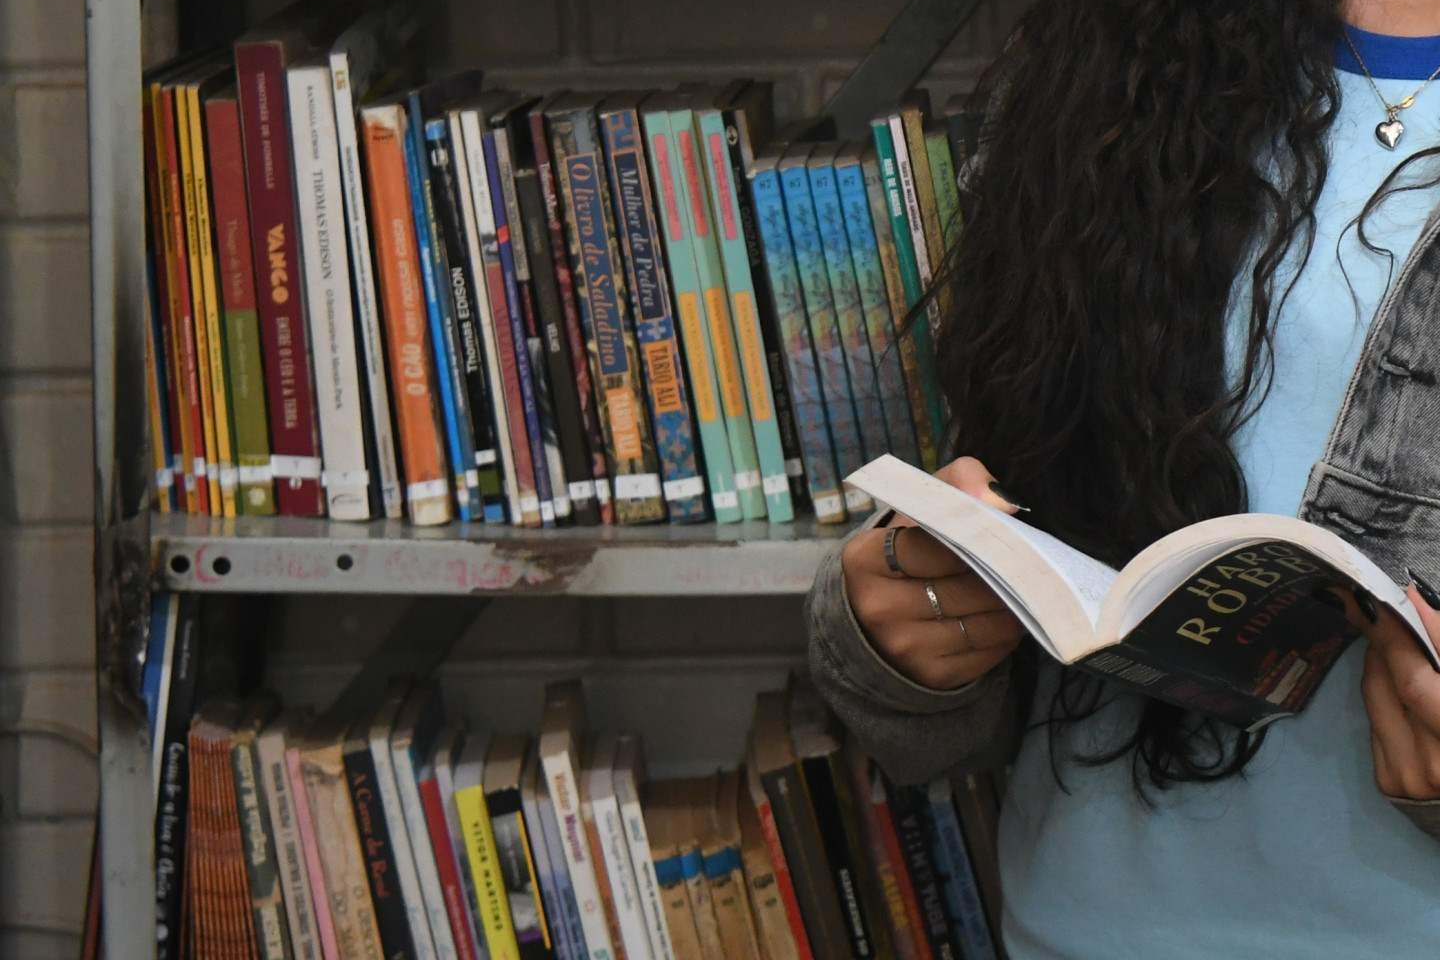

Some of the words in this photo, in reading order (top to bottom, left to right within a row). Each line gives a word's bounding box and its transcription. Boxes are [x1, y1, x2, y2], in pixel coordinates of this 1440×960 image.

[569, 160, 591, 182] O
[618, 165, 647, 230] Mulher
[310, 170, 330, 226] THOMAS
[573, 186, 601, 237] livro
[265, 223, 291, 304] VANGO
[316, 228, 334, 279] EDISON
[583, 239, 606, 266] de
[630, 230, 650, 252] de
[450, 266, 470, 319] EDISON
[634, 255, 661, 307] Pedra
[587, 269, 624, 366] Saladino
[458, 320, 479, 373] Thomas
[480, 868, 506, 931] MARTINS
